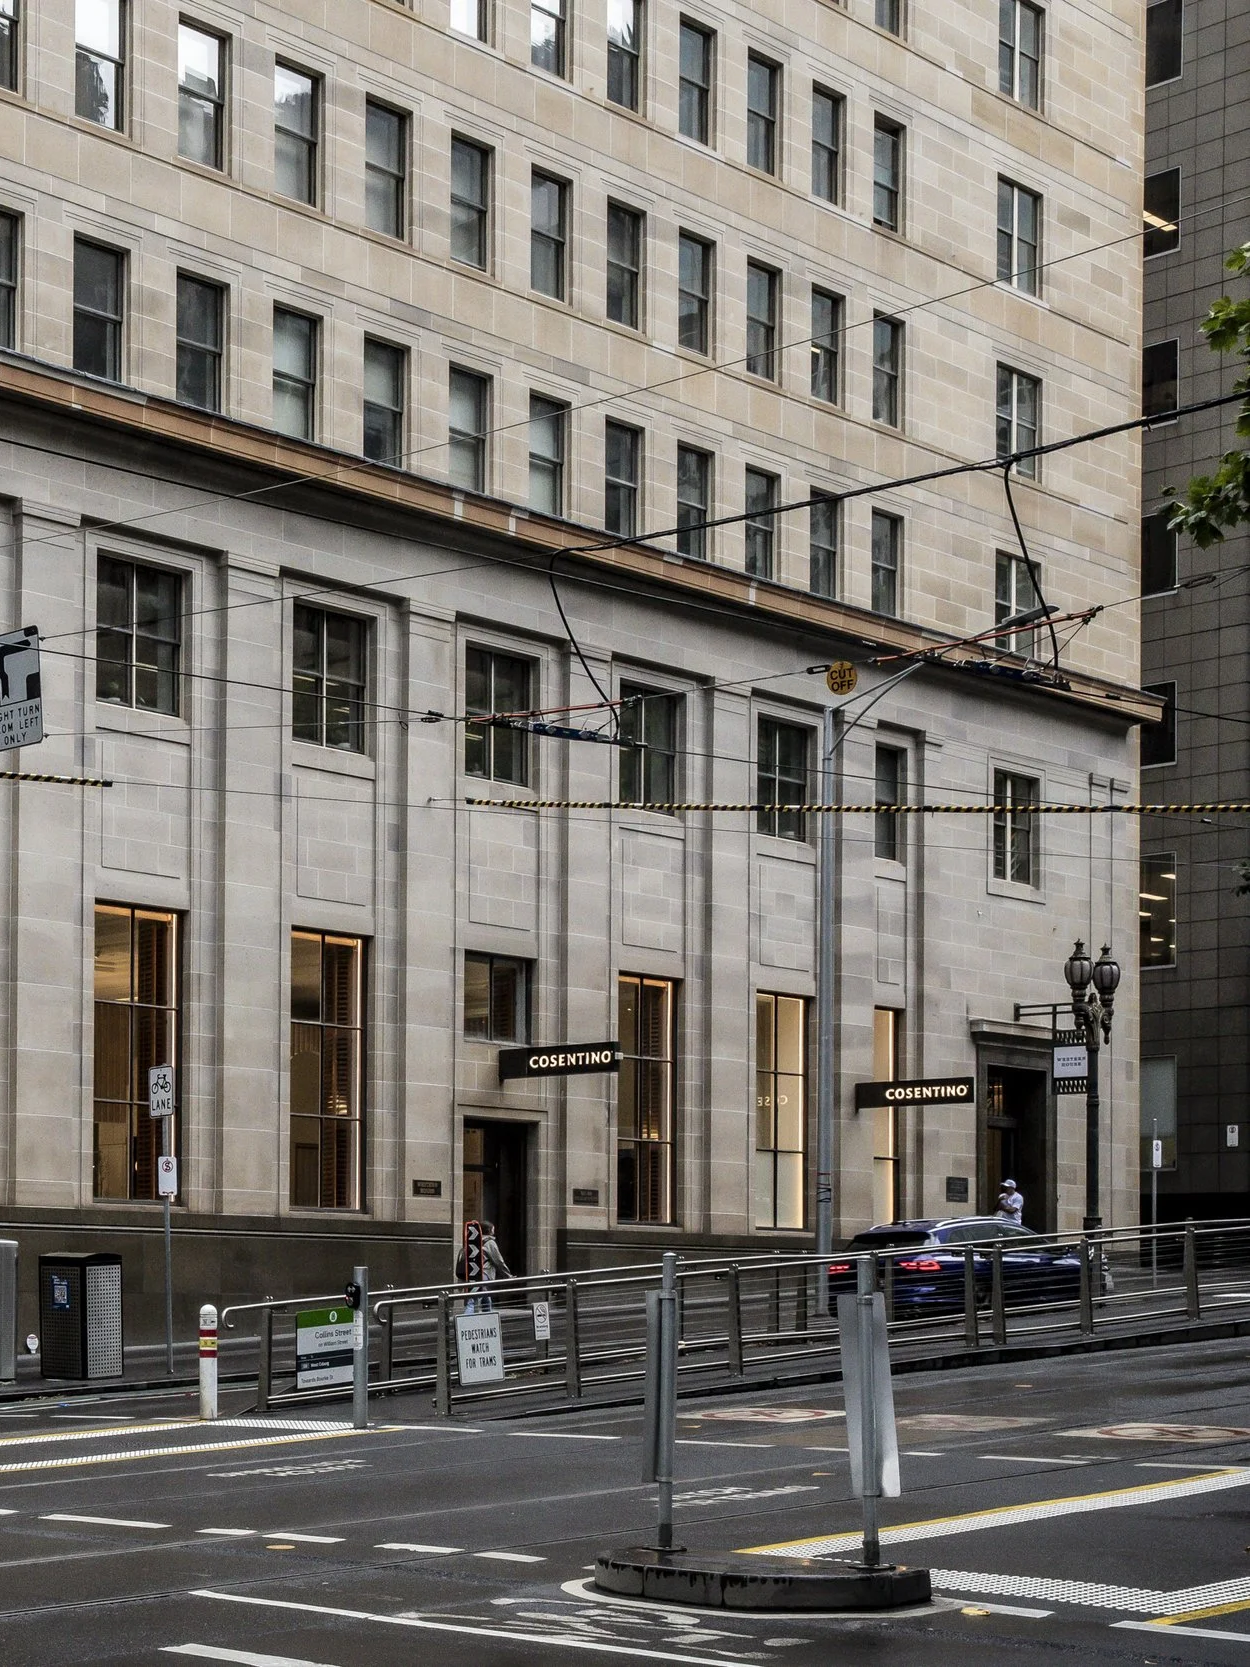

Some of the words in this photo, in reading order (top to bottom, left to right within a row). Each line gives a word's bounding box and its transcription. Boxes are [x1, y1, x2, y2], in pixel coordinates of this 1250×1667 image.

[830, 667, 853, 680] CUT
[832, 679, 854, 691] OFF
[17, 703, 40, 718] TURN
[19, 716, 39, 730] LEFT
[4, 732, 27, 745] ONLY
[529, 1050, 611, 1068] COSENTINO
[885, 1084, 968, 1100] COSENTINO
[151, 1098, 171, 1111] LANE
[314, 1331, 333, 1339] Collins
[334, 1328, 352, 1337] Street
[461, 1327, 497, 1341] PEDESTRIANS
[471, 1342, 490, 1353] WATCH
[466, 1358, 476, 1369] FOR
[479, 1355, 497, 1367] TRAMS
